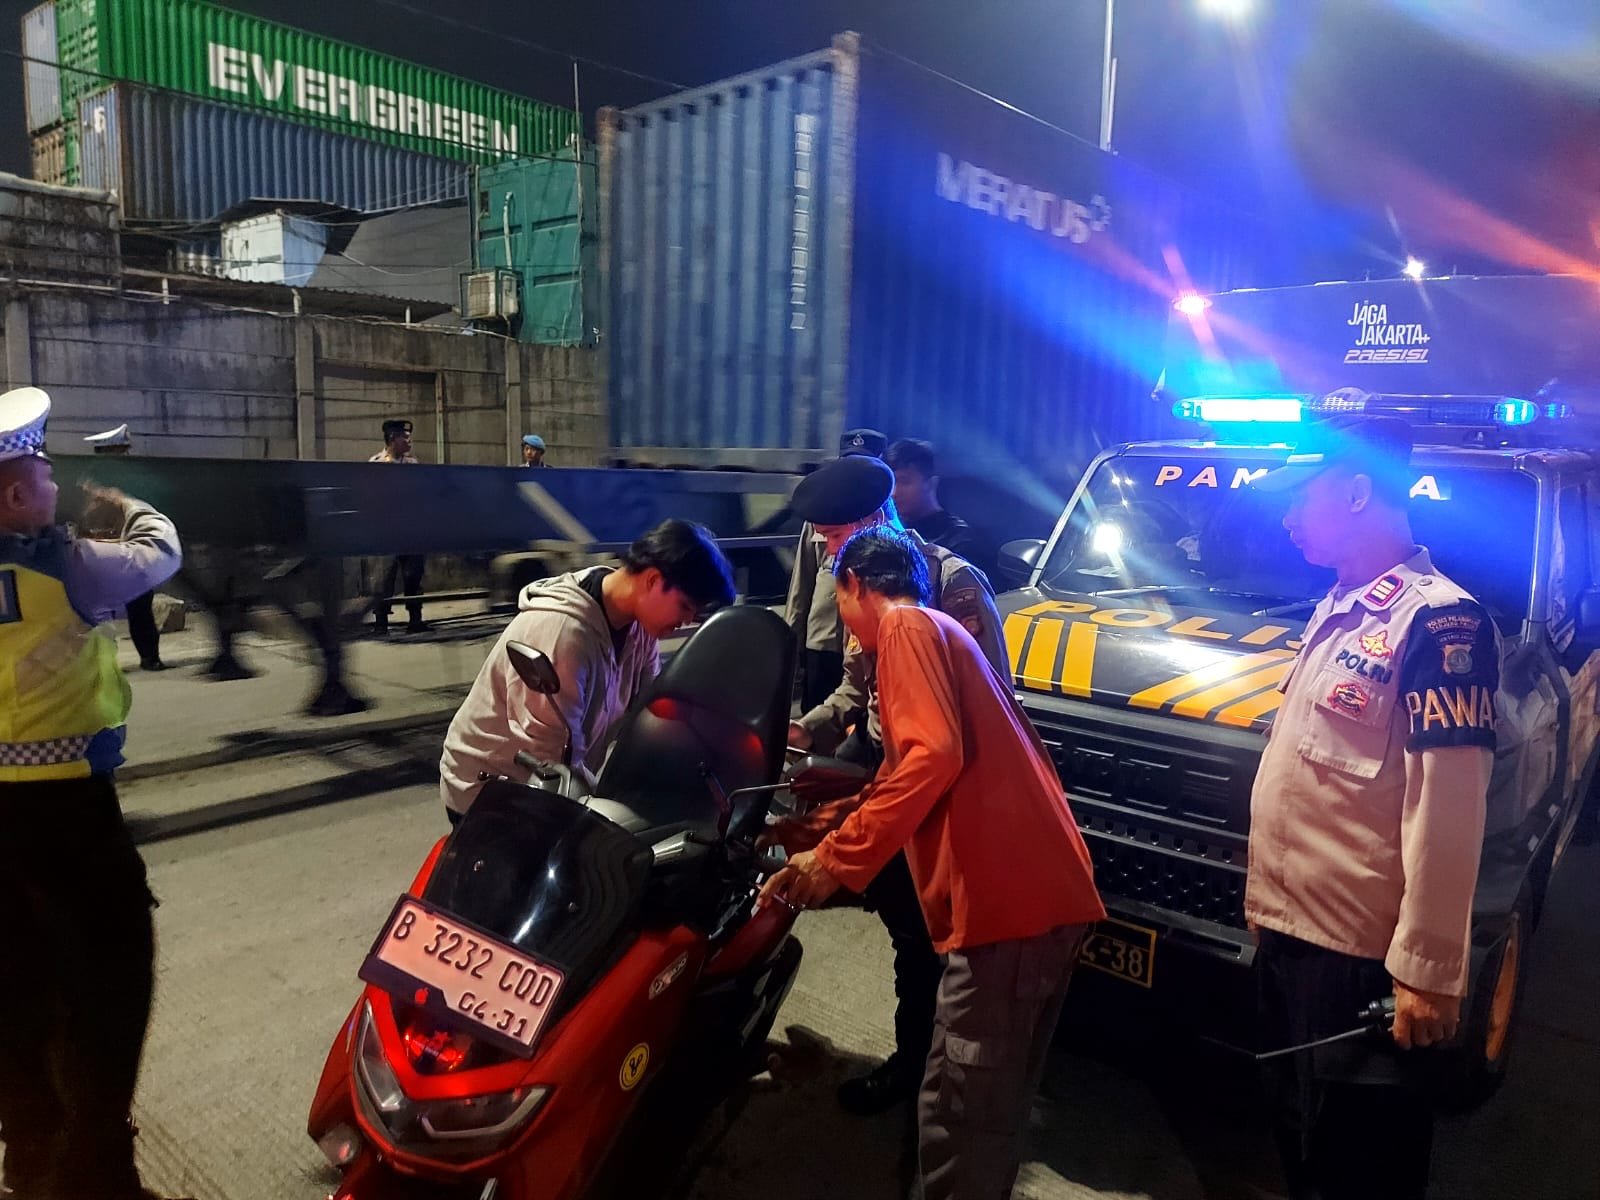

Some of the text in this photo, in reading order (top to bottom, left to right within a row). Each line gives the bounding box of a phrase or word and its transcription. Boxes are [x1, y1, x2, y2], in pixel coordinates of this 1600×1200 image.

[208, 41, 518, 160] EVERGREEN
[935, 152, 1092, 244] MERATUS
[1347, 302, 1387, 326] JAGA
[1344, 350, 1429, 361] PRESISI
[1015, 600, 1304, 650] POLI
[1336, 648, 1393, 685] POLRI
[393, 910, 417, 940] B
[424, 924, 494, 979] 3232
